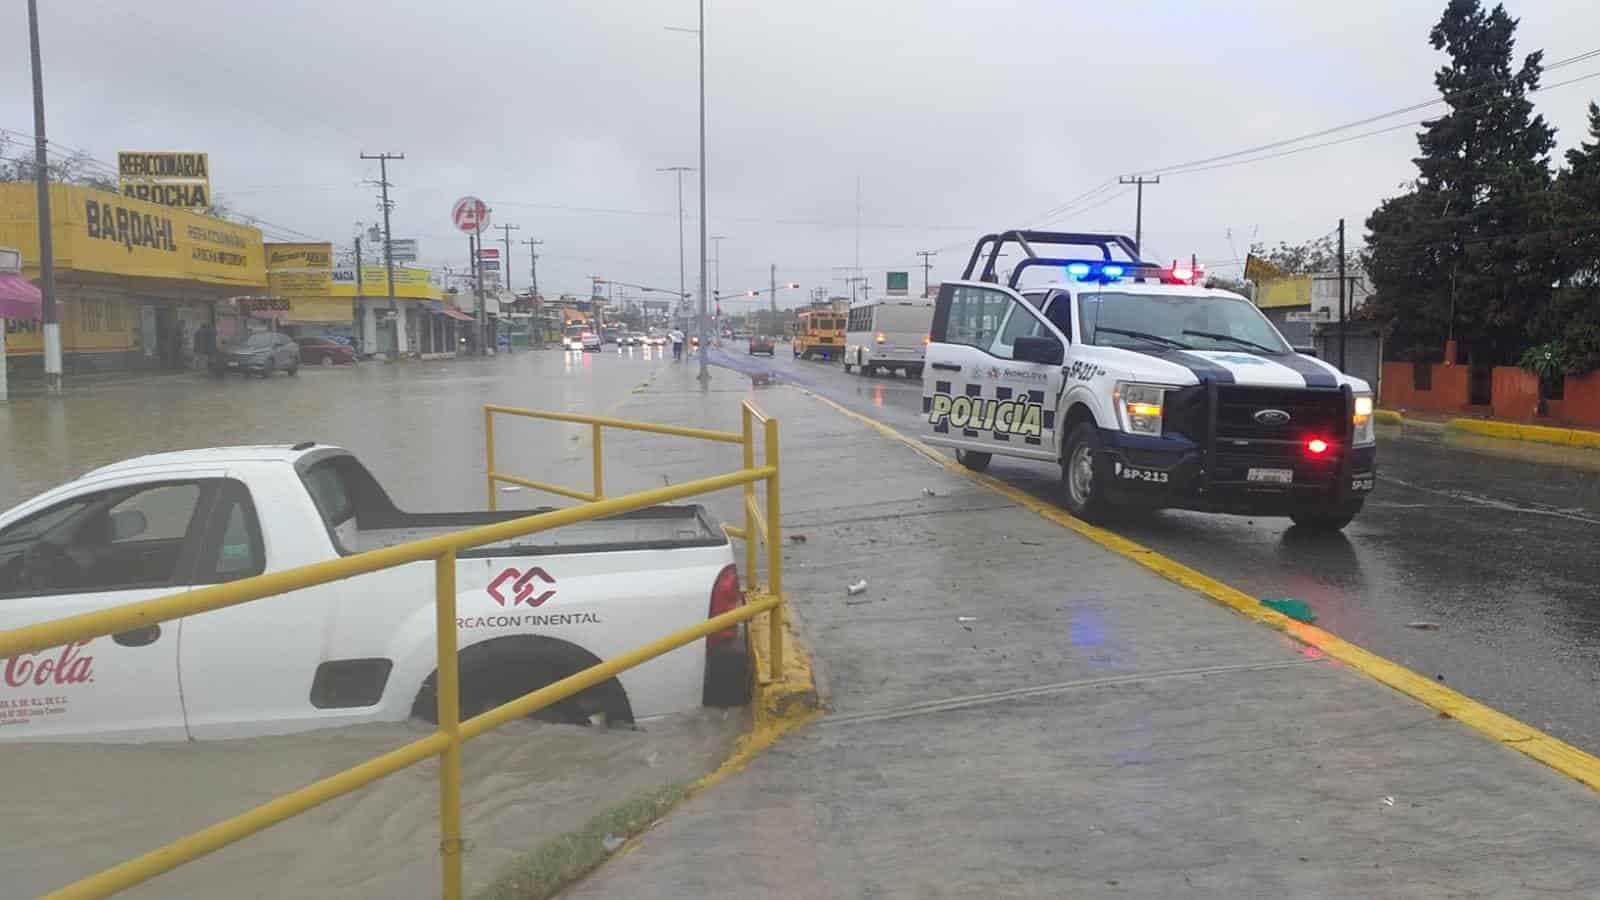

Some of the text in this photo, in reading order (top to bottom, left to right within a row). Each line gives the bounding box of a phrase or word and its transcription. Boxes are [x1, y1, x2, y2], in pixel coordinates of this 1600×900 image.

[124, 184, 208, 208] AROCHA
[86, 200, 177, 251] BARDAHL
[929, 394, 1041, 436] POLICÍA
[1123, 467, 1169, 482] SP-213
[5, 640, 93, 687] Cola
